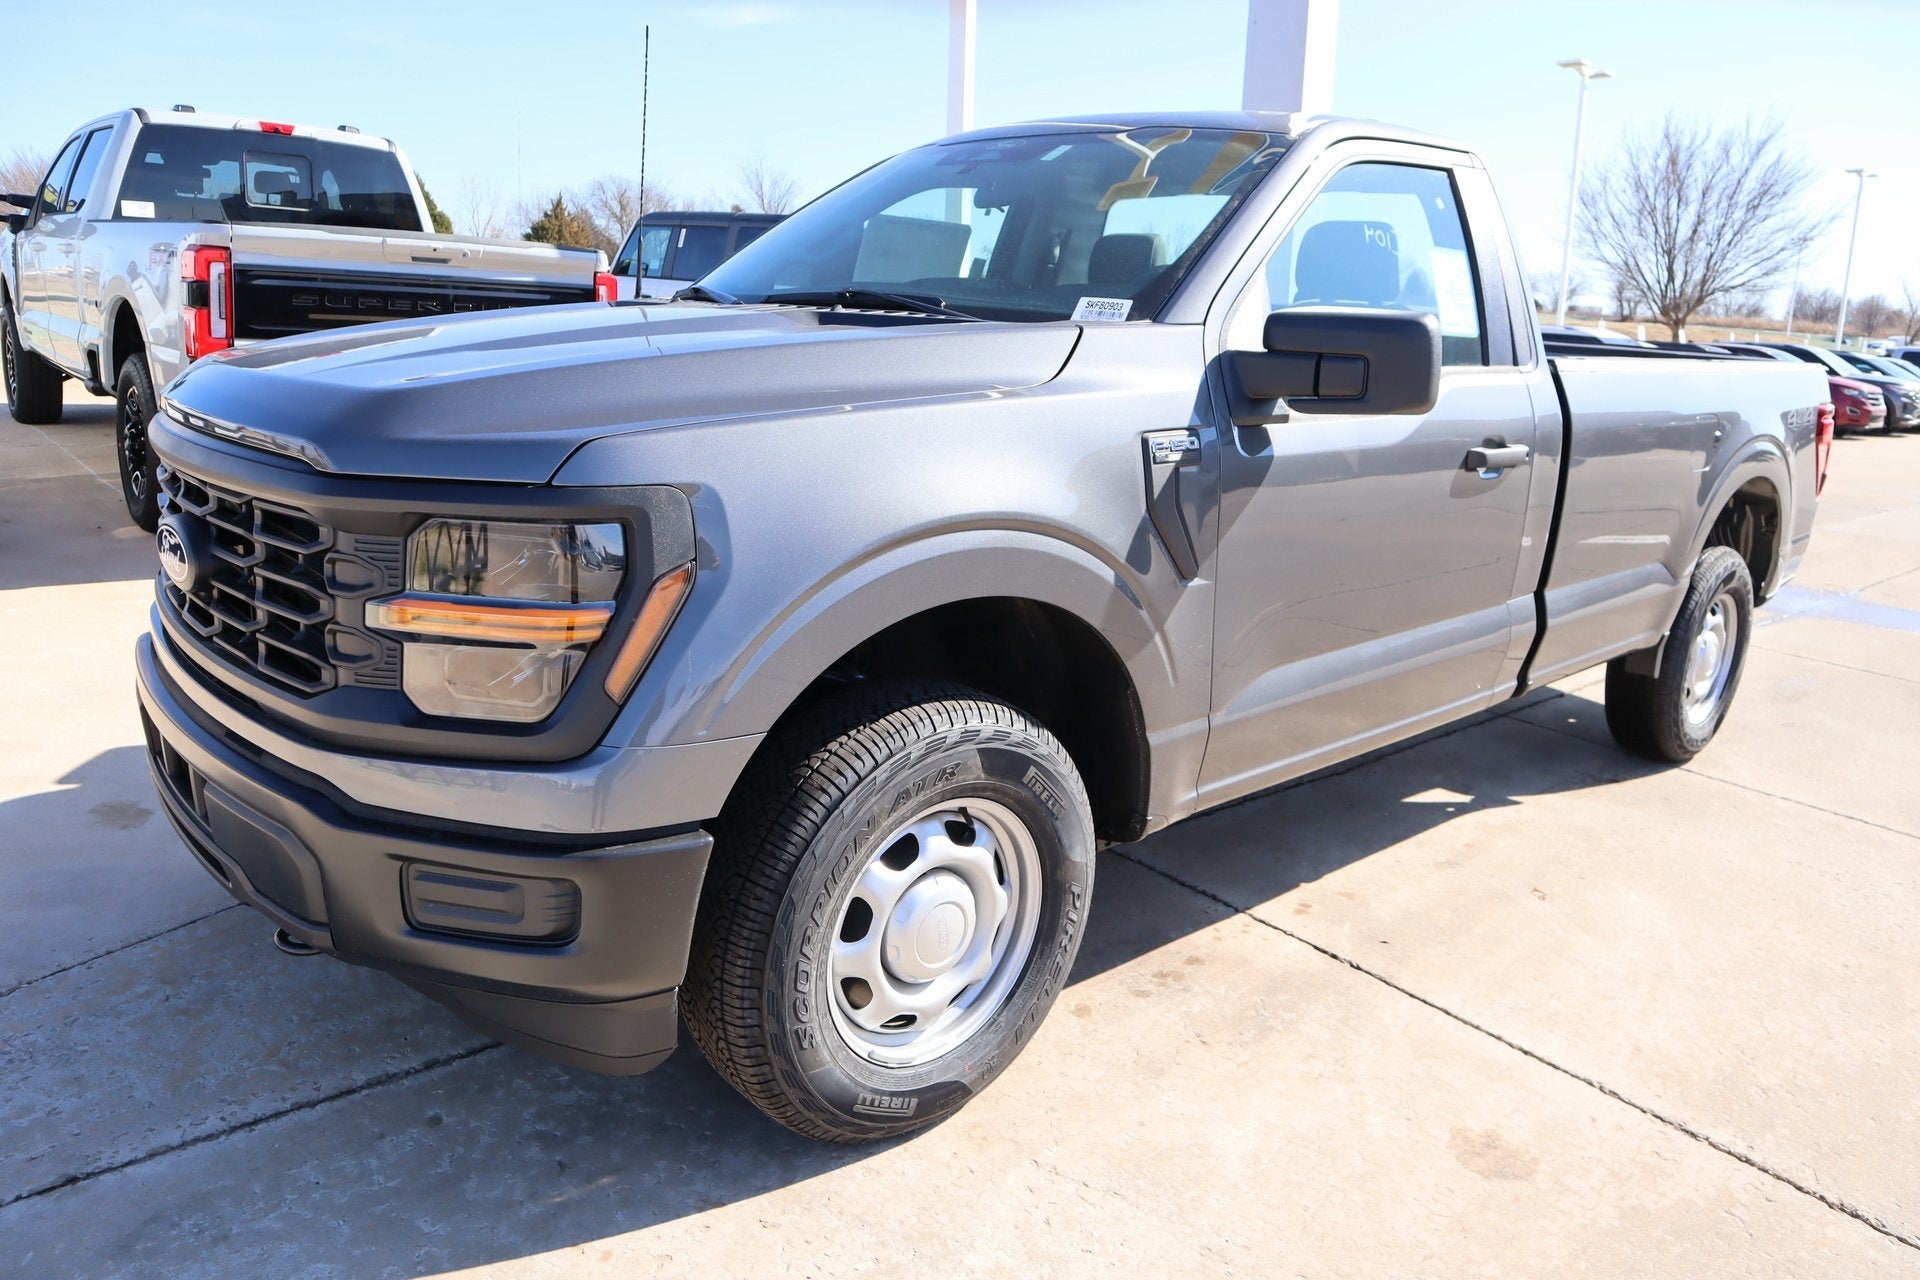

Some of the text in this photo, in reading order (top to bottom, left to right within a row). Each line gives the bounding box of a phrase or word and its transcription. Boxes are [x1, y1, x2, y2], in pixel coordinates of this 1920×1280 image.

[292, 295, 441, 312] SUPER
[1085, 300, 1124, 311] SKF80903
[1151, 437, 1200, 453] F-150
[794, 760, 963, 1050] SCORPION ATR
[1014, 881, 1083, 1046] PIRELLI
[853, 1092, 919, 1118] PIRELLI
